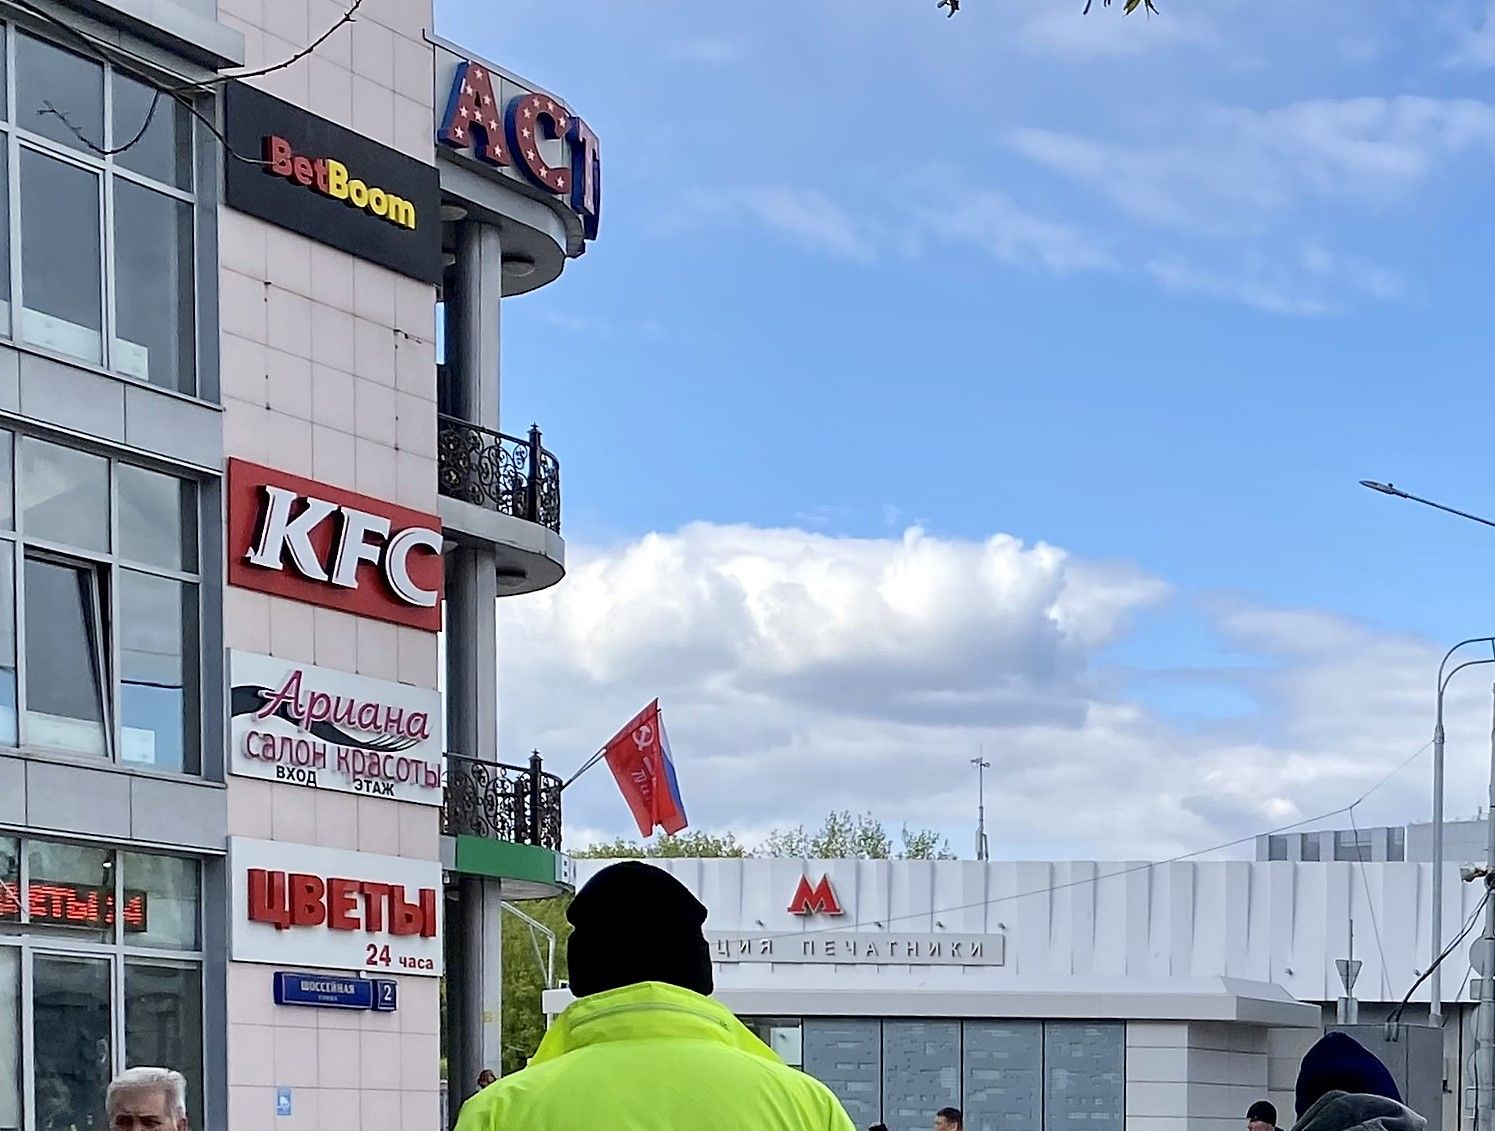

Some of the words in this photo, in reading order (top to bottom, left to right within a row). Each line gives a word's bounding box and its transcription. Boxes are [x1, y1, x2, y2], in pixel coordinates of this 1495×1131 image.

[264, 134, 416, 231] BetBoom
[245, 485, 443, 607] KFC
[257, 669, 430, 740] Ариана
[246, 730, 327, 769] салон
[336, 746, 441, 788] красоты
[275, 764, 317, 787] ВХОД
[354, 777, 395, 797] ЭТАЖ
[247, 868, 437, 937] ЦВЕТЫ
[366, 943, 391, 967] 24
[399, 956, 434, 970] часа
[717, 938, 774, 958] ЦИЯ
[801, 939, 985, 959] ПЕЧАТНИКИ
[383, 984, 393, 1001] 2
